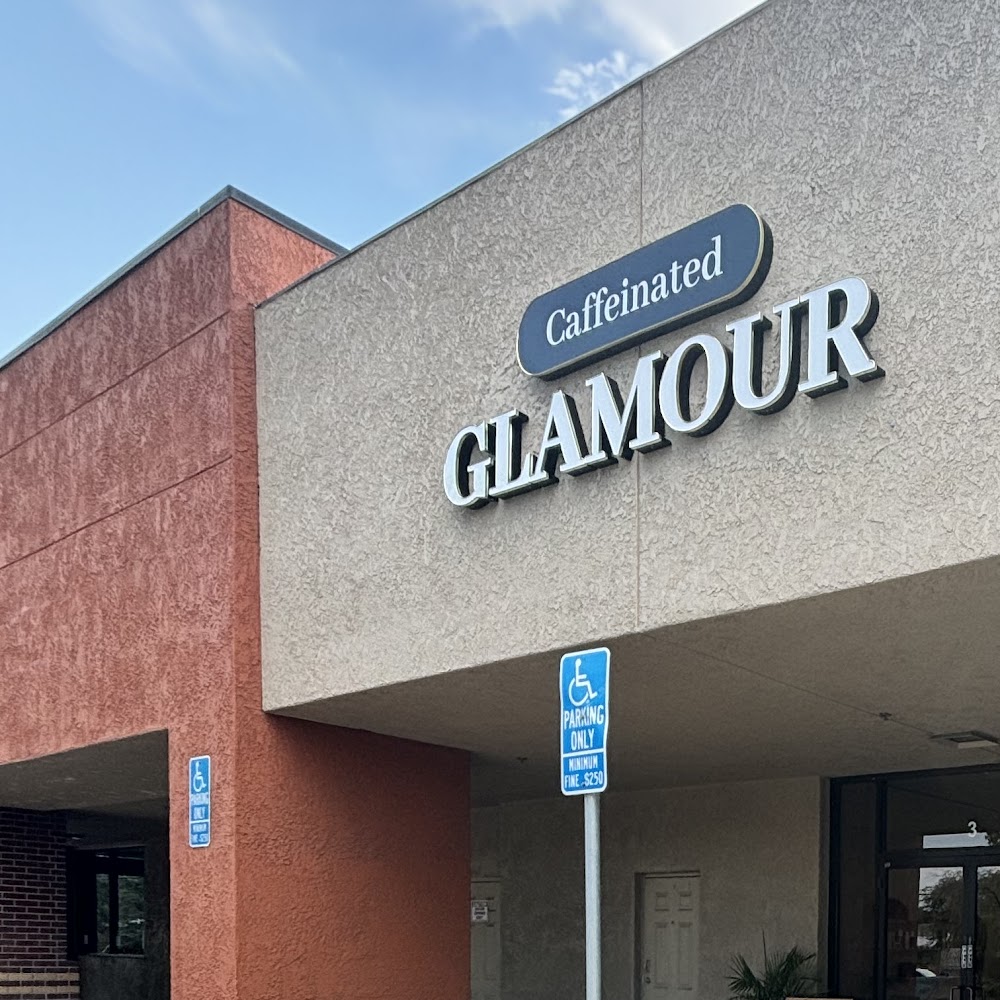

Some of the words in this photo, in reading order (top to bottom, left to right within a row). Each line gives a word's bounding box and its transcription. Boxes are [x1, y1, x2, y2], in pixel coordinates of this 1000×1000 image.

[545, 234, 724, 346] Caffeinated
[443, 277, 882, 508] GLAMOUR
[564, 704, 604, 730] PARKING
[571, 728, 594, 751] ONLY
[569, 754, 598, 772] MINIMUM
[564, 773, 580, 789] FINE
[584, 770, 604, 787] $250
[967, 820, 978, 838] 3
